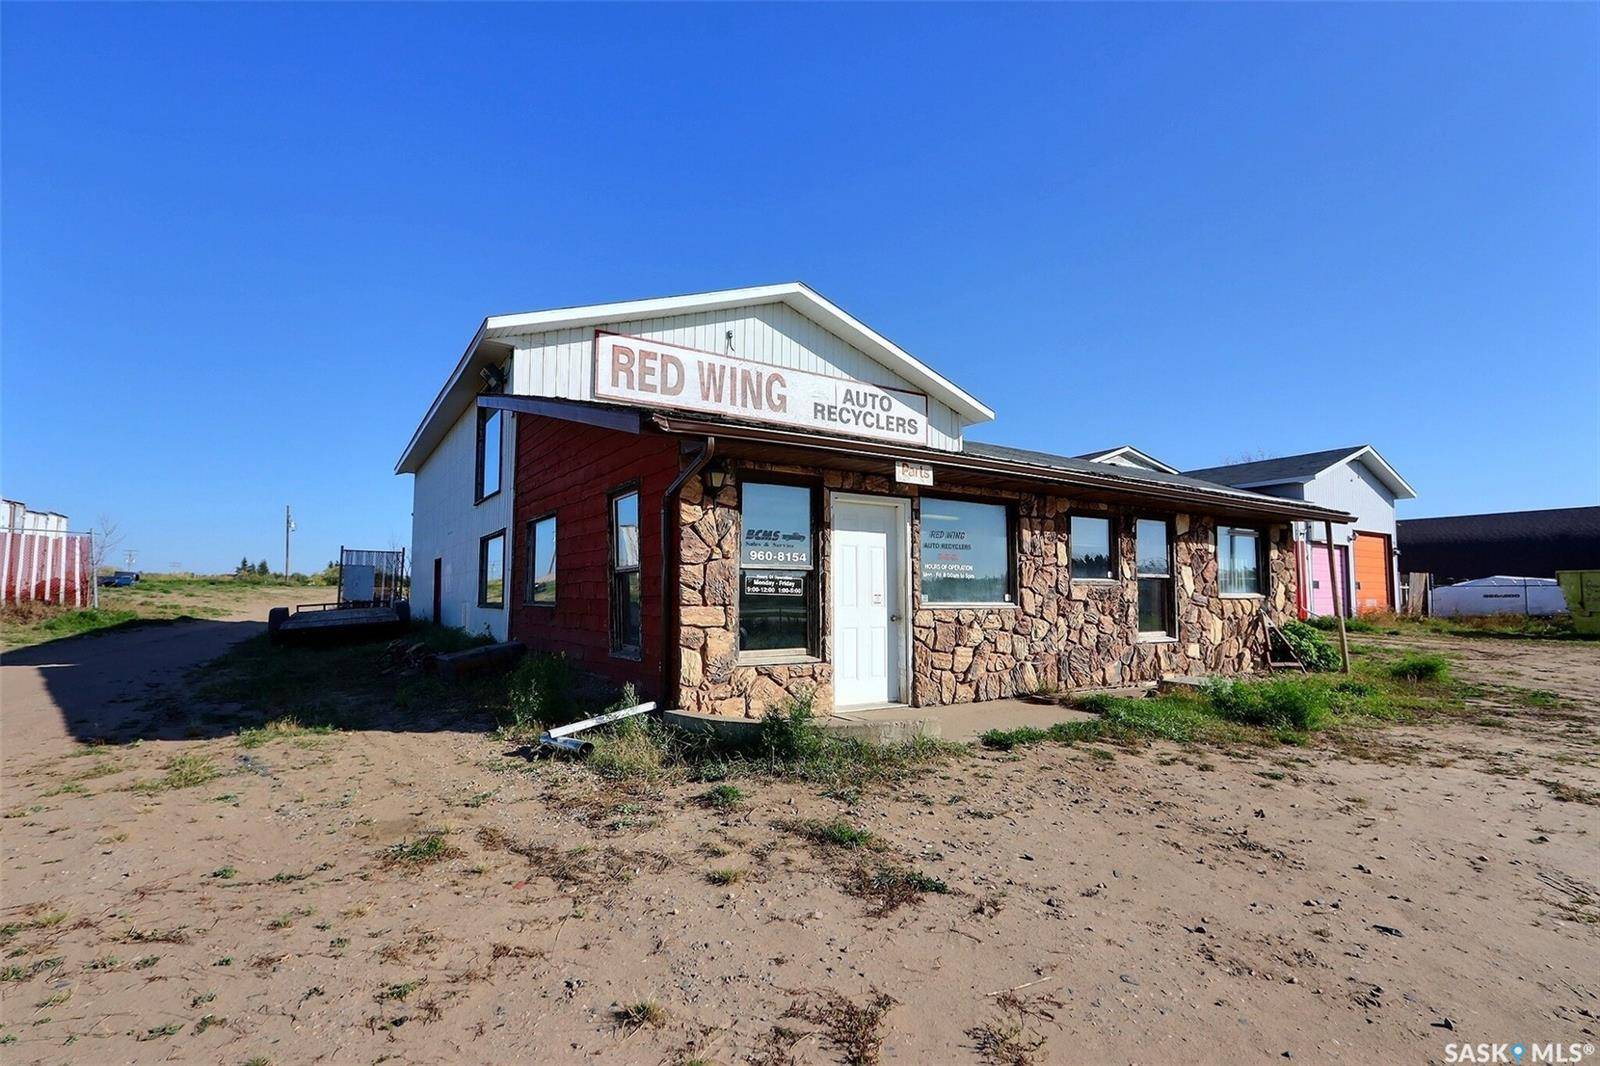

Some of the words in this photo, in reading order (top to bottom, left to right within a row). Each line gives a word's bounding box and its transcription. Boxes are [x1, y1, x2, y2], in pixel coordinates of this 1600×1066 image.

[611, 344, 685, 396] RED
[697, 360, 787, 414] WING
[843, 388, 893, 412] AUTO
[813, 402, 918, 435] RECYCLERS
[902, 462, 930, 479] Parts
[745, 529, 781, 541] BCMS
[930, 530, 945, 539] RED
[946, 531, 966, 540] WING
[749, 550, 807, 562] 960-8154
[753, 579, 775, 587] Monday
[779, 580, 796, 588] Friday
